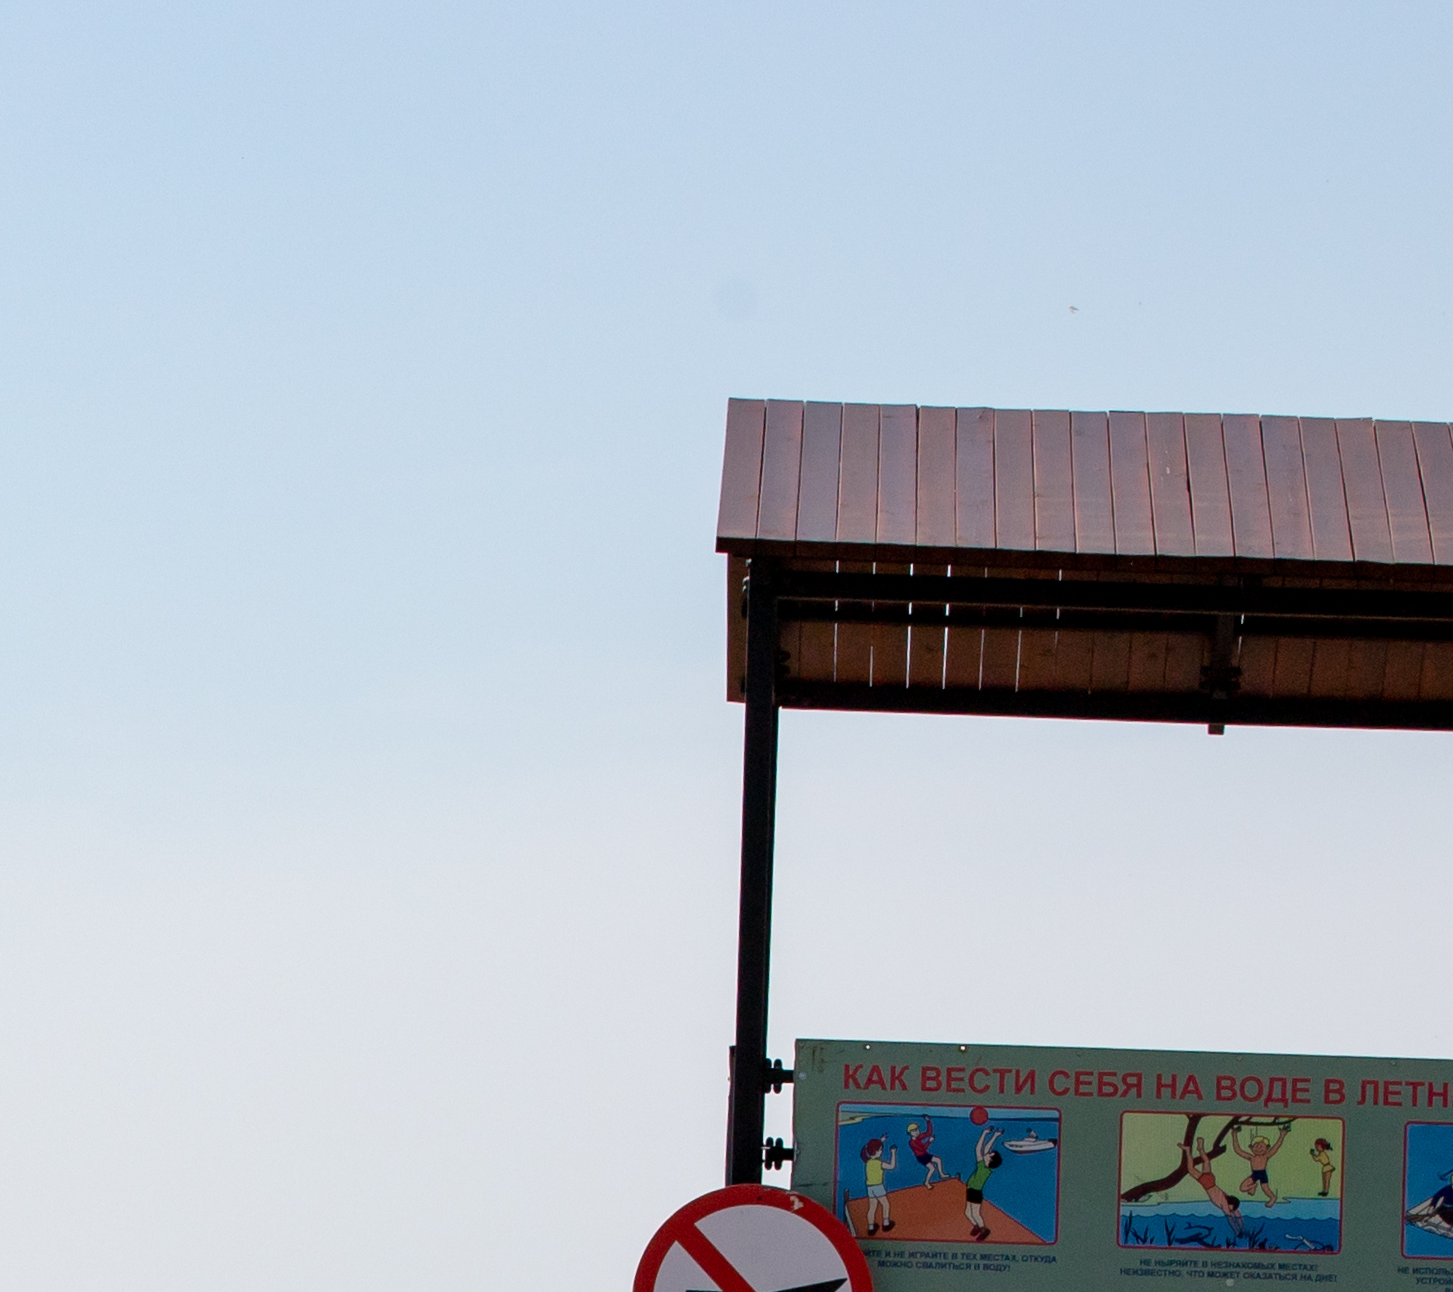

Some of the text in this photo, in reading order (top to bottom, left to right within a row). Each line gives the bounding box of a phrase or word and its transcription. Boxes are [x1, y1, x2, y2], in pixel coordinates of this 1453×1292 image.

[843, 1063, 909, 1091] КАК
[920, 1066, 1035, 1095] ВЕСТИ
[1048, 1069, 1142, 1098] СЕБЯ
[1155, 1073, 1203, 1100] НА
[1215, 1075, 1311, 1108] ВОДЕ
[1323, 1078, 1345, 1104] В
